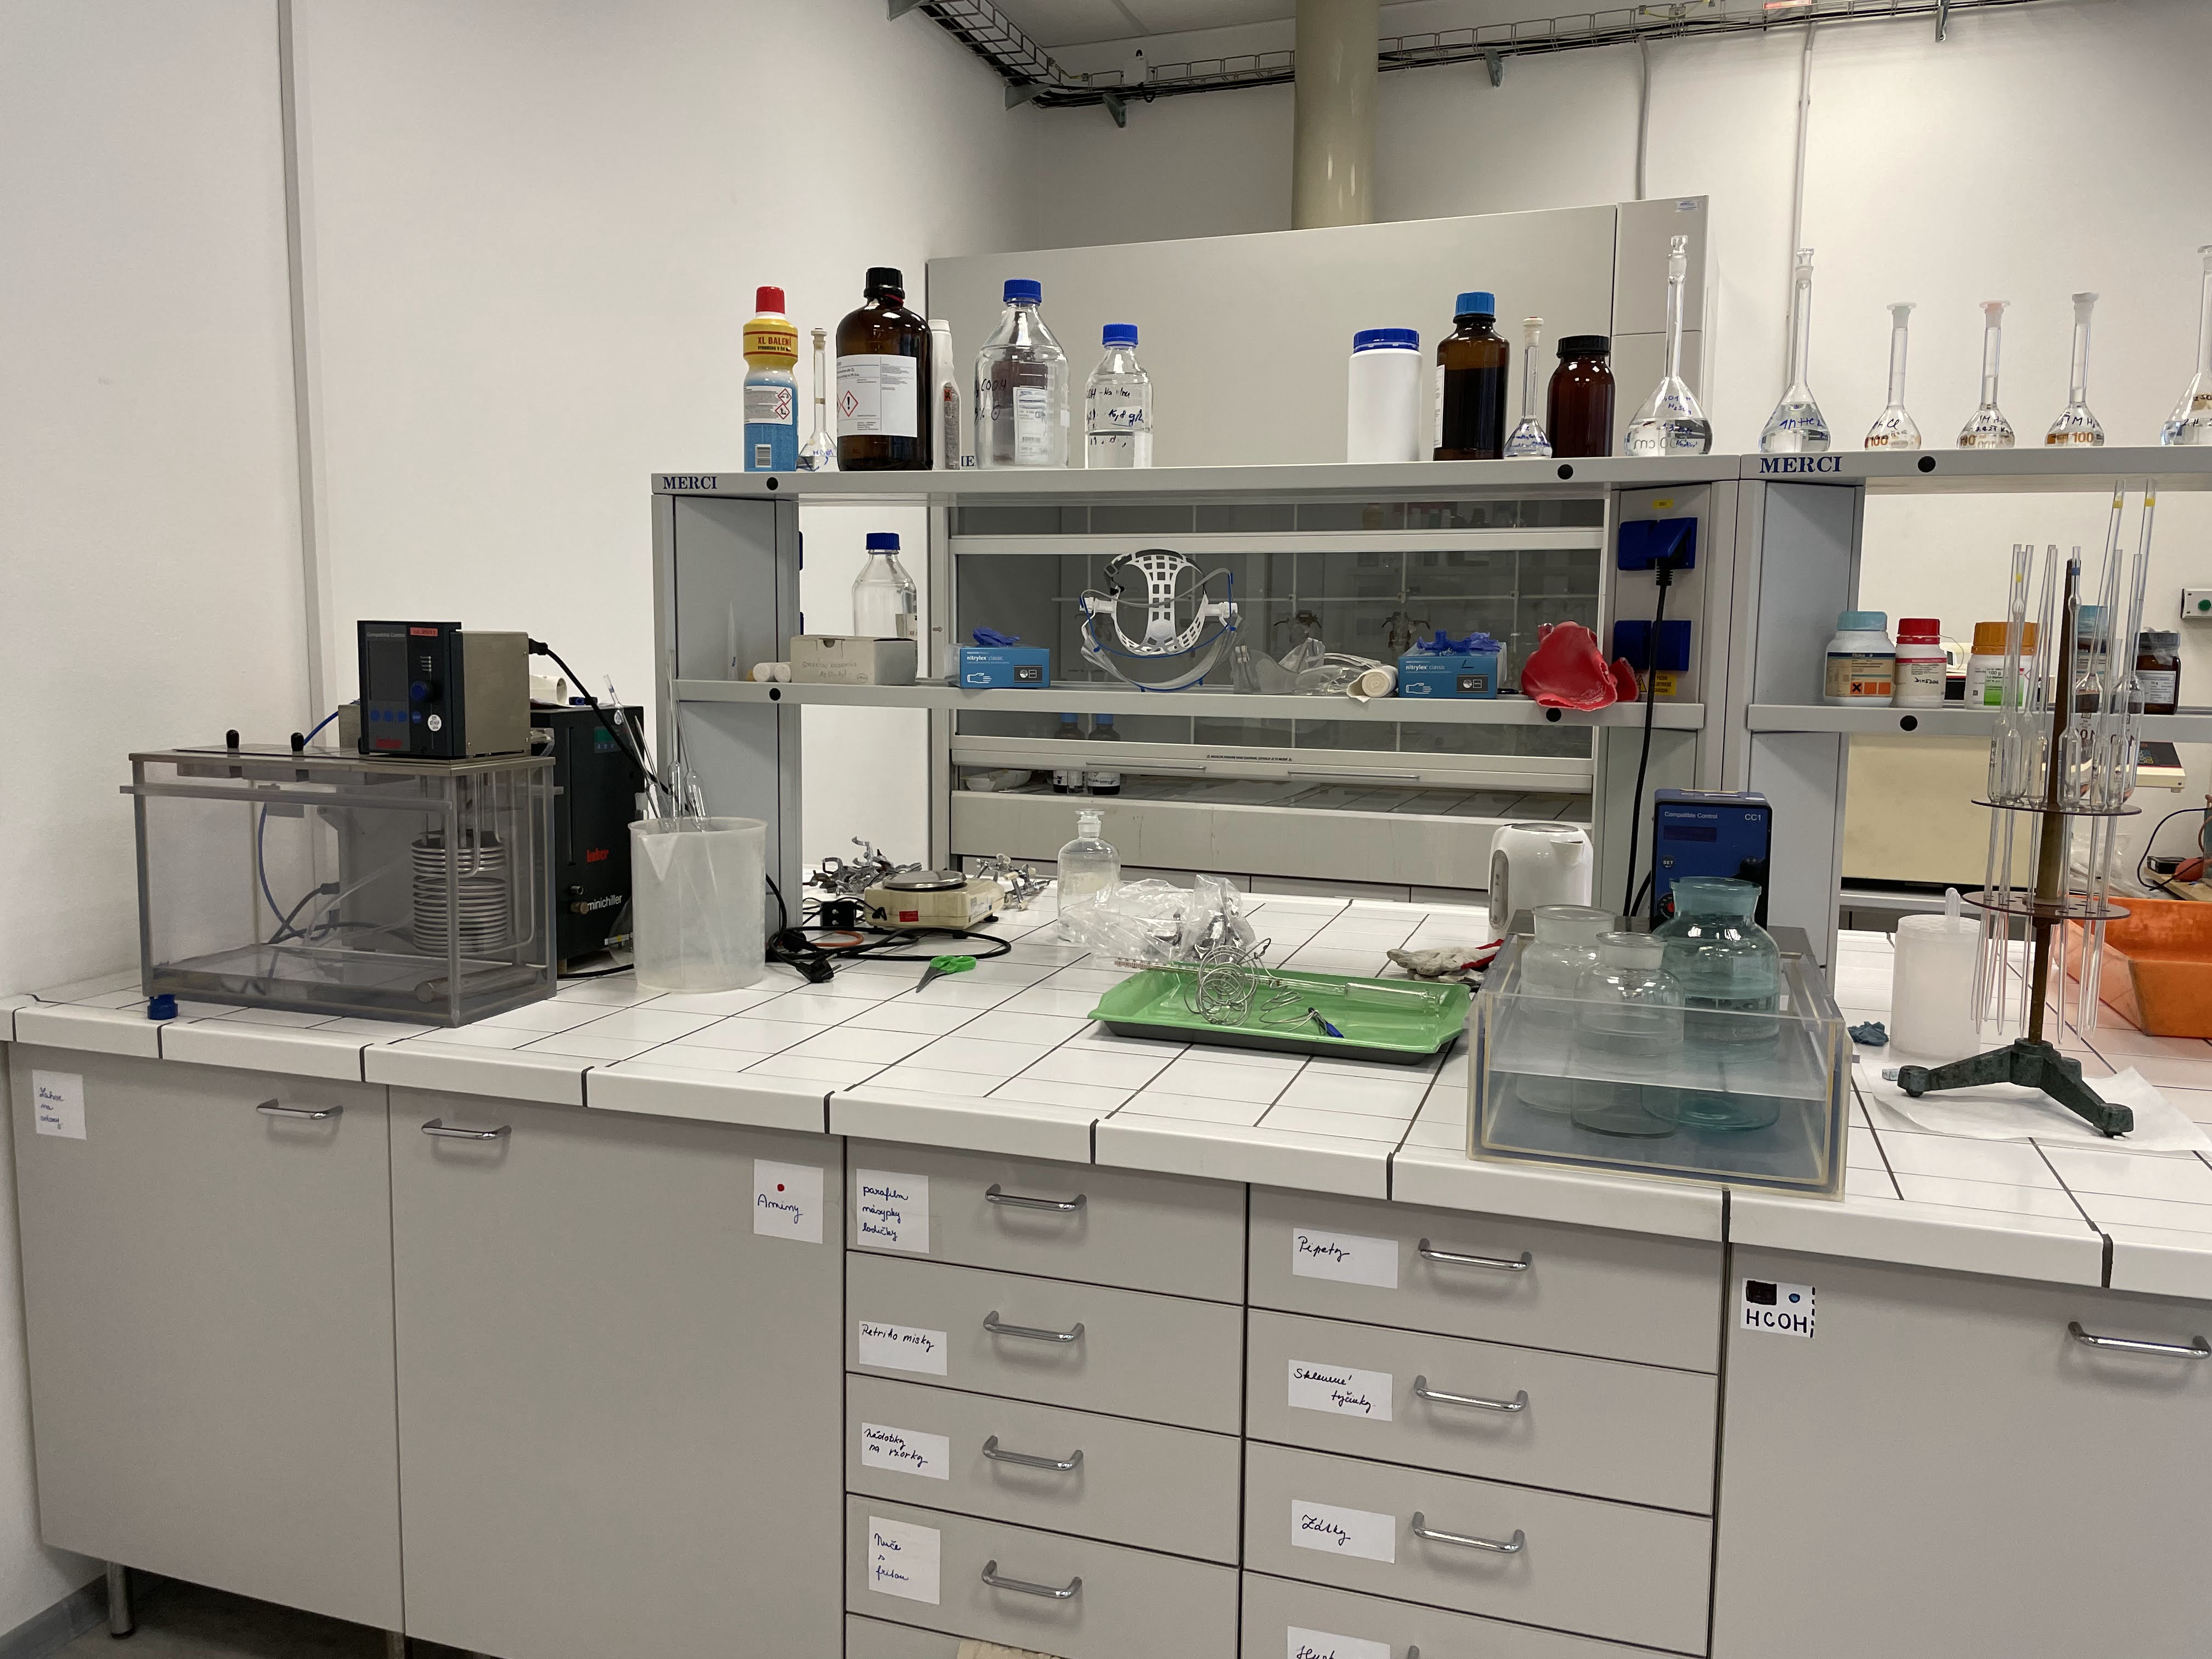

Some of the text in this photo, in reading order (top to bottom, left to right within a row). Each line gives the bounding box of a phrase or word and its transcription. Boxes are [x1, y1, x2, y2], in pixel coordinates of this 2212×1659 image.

[768, 336, 791, 346] BALENÍ
[1870, 435, 1888, 447] 100
[2072, 432, 2094, 443] 100
[1759, 456, 1843, 473] MERCI
[663, 476, 717, 489] MERCI
[588, 894, 623, 911] minichiller
[863, 1186, 909, 1201] parafilm
[758, 1194, 803, 1224] Aminy
[862, 1222, 898, 1242] lodičky
[1298, 1236, 1350, 1262] Pipety
[1746, 1308, 1807, 1334] HCOH
[902, 1334, 934, 1353] misky
[1331, 1390, 1373, 1414] tyčinky
[869, 1444, 880, 1453] na
